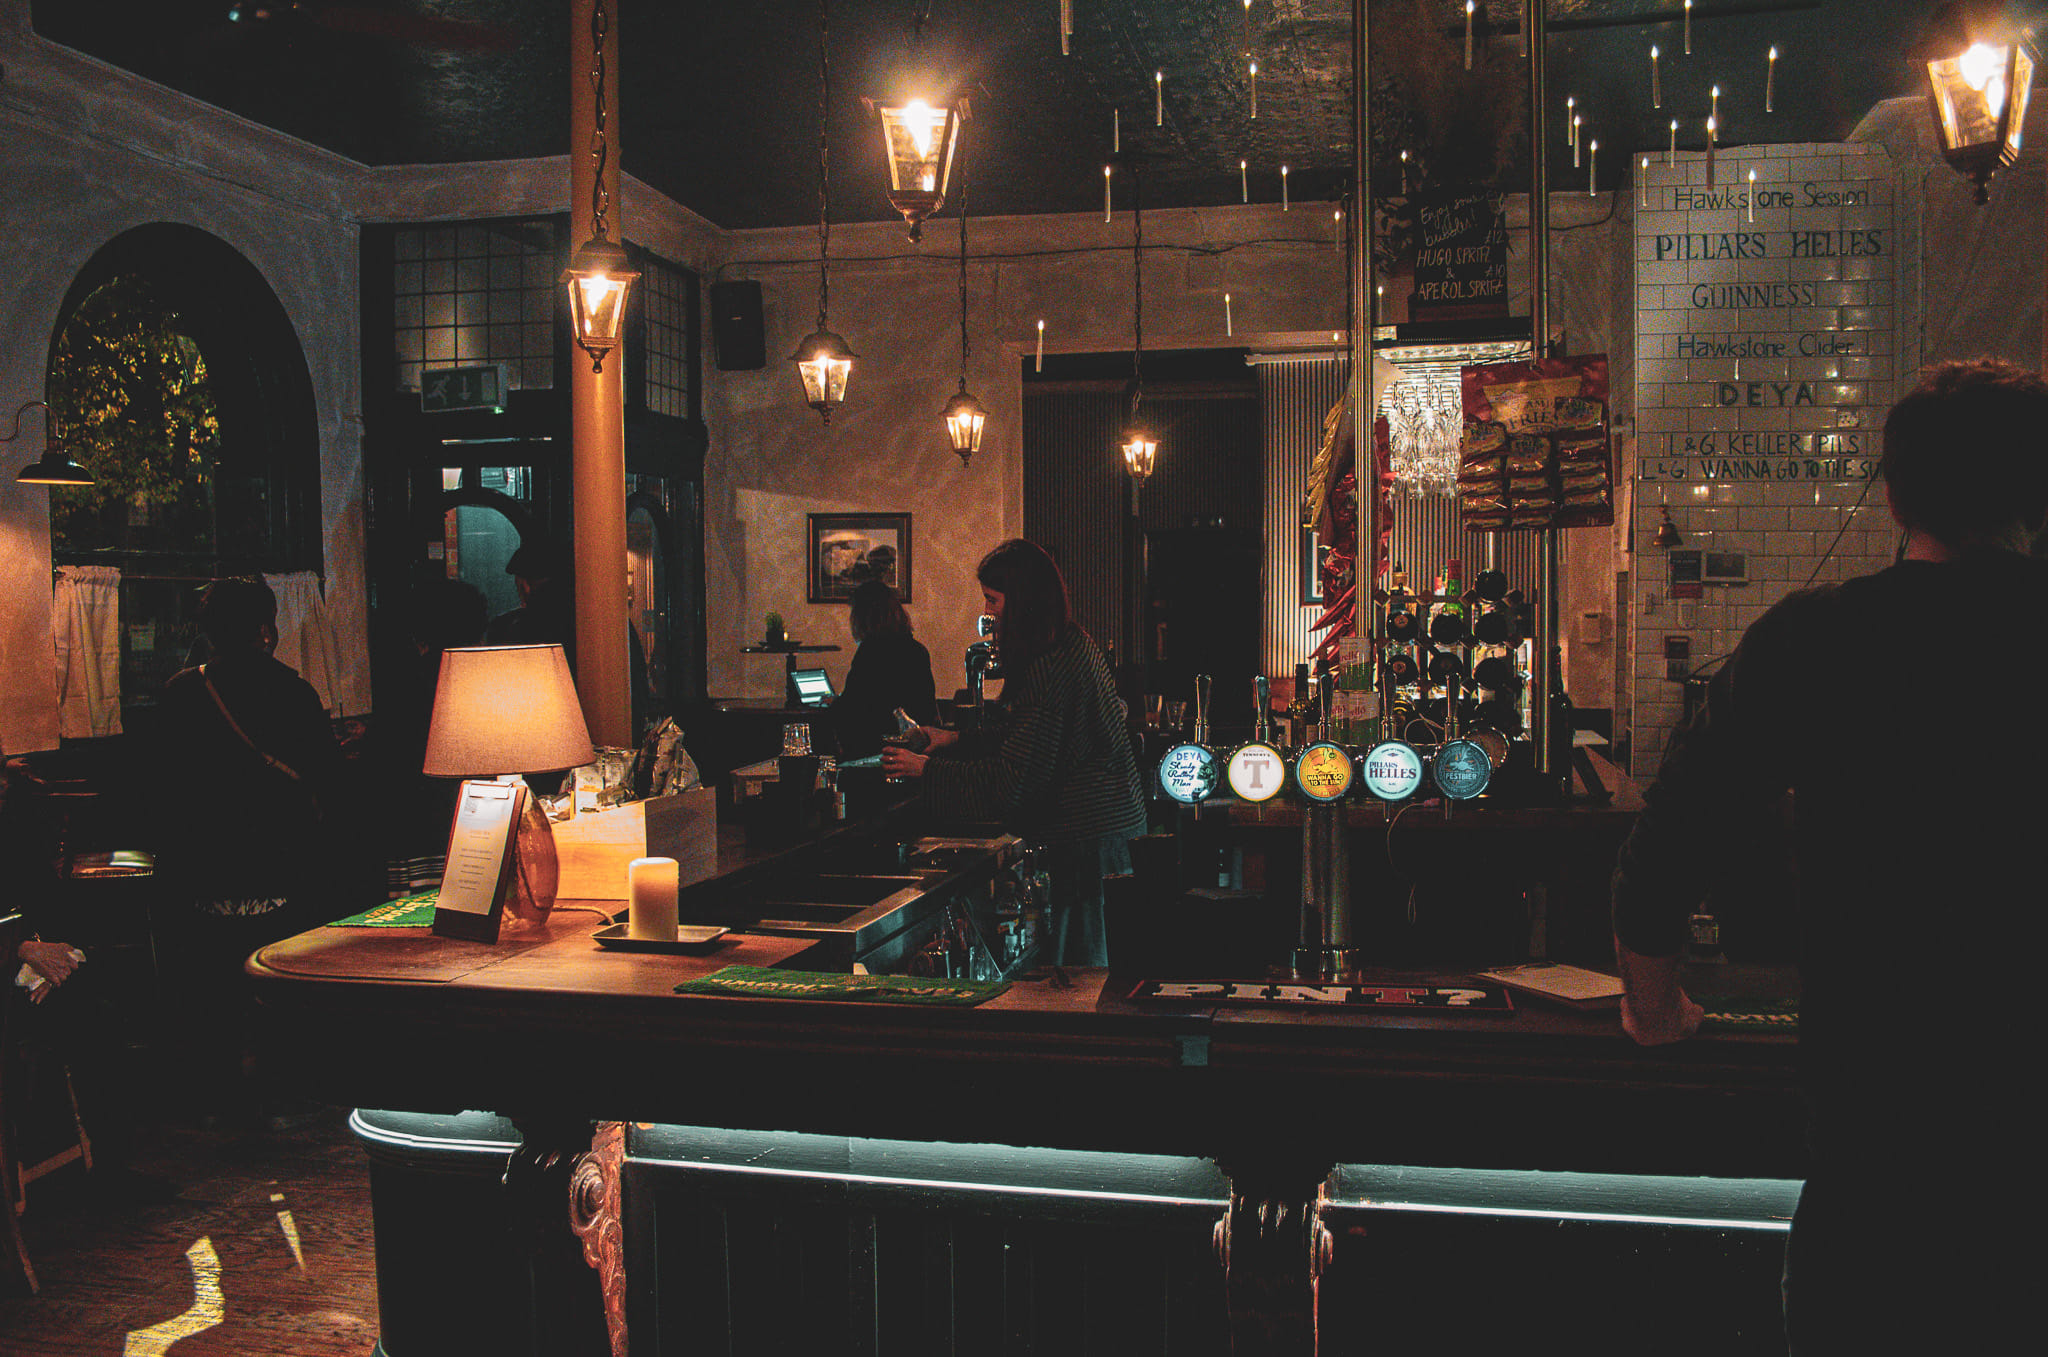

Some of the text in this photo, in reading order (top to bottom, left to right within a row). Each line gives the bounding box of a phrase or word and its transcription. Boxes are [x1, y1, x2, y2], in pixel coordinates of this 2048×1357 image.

[1674, 183, 1868, 210] Hawksone Session
[1655, 230, 1883, 261] PILLARS HELLES
[1416, 247, 1452, 268] HUGO
[1446, 267, 1455, 279] &
[1418, 280, 1504, 300] APEROL SPRITZ
[1692, 283, 1814, 309] GUINNESS
[1677, 333, 1855, 358] Hawkstone Cider
[1718, 383, 1815, 407] DEYA
[1728, 433, 1804, 456] KELLER
[1817, 434, 1860, 456] PILS
[1700, 459, 1772, 480] WANNA
[1776, 460, 1799, 480] GO
[1803, 459, 1820, 479] TO
[1823, 459, 1854, 479] THE
[1859, 460, 1884, 480] SU
[1176, 752, 1202, 761] DEYA
[1244, 760, 1270, 789] T
[1333, 773, 1345, 781] GO
[1369, 767, 1417, 780] HELLES
[1151, 983, 1488, 1006] PINT?
